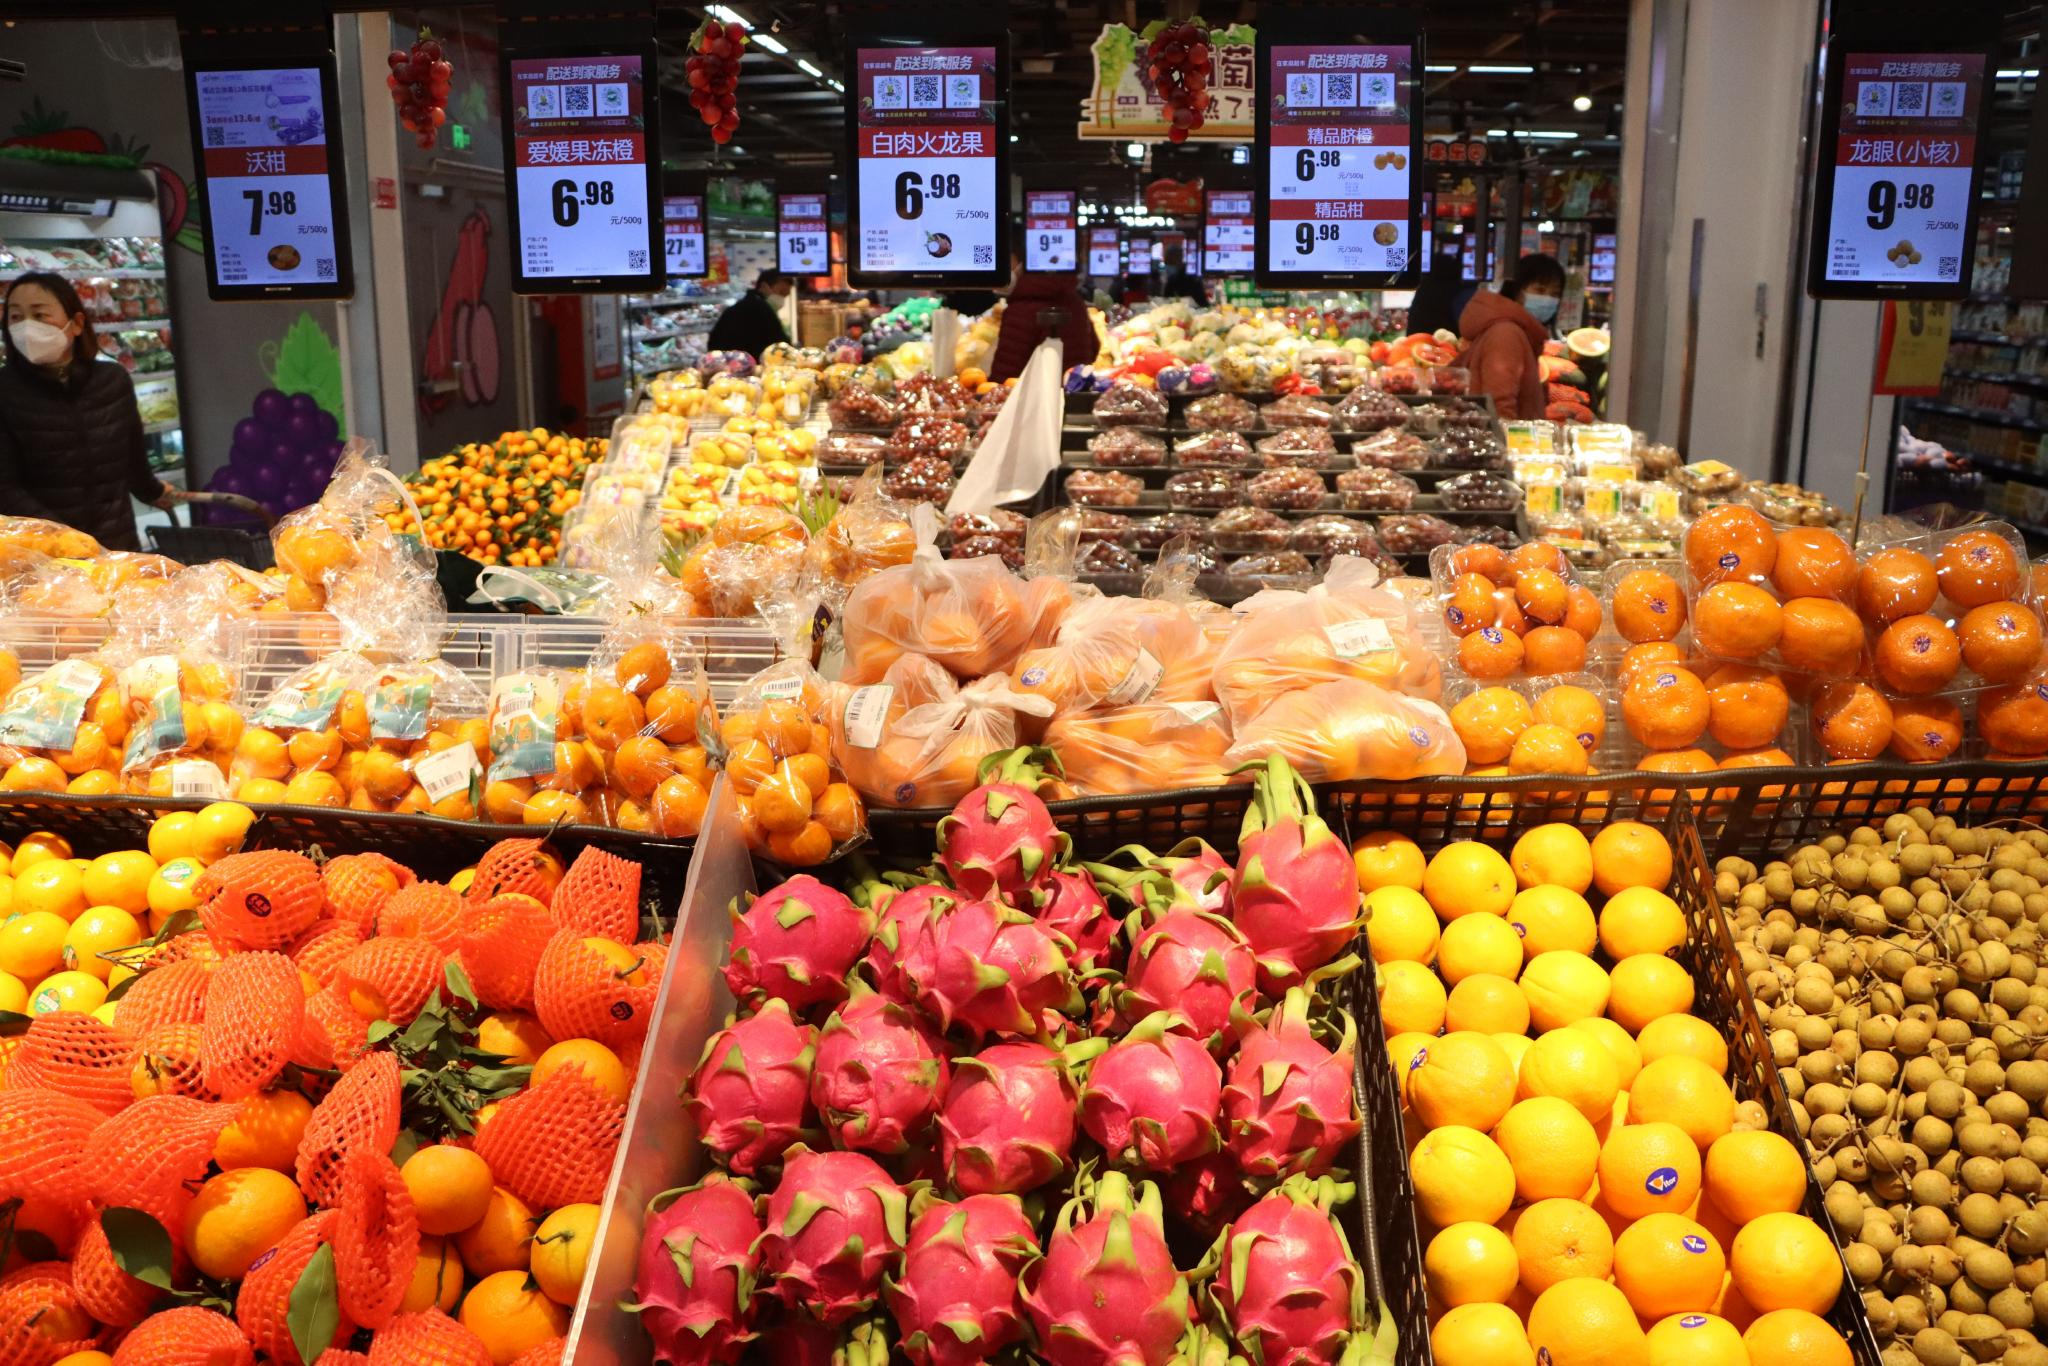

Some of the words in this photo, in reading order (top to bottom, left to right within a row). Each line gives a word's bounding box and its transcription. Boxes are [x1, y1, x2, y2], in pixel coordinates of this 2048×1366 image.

[893, 55, 973, 71] 配送到家服务
[1307, 53, 1389, 69] 配送到家服务
[1880, 61, 1963, 77] 配送到家服务
[546, 64, 621, 81] 配送到家服务
[872, 131, 984, 155] 白肉火龙果
[1307, 127, 1373, 145] 精品脐橙
[527, 138, 635, 164] 爱媛果冻橙
[1848, 139, 1961, 165] 龙眼(小核)
[245, 150, 286, 174] 沃柑
[1295, 148, 1341, 182] 6.98
[1337, 171, 1364, 180] 元/500g
[551, 178, 615, 228] 6.98
[894, 170, 961, 221] 6.98
[242, 189, 297, 236] 7.98
[955, 209, 990, 221] 元/500g
[1314, 201, 1364, 219] 精品柑
[1865, 180, 1935, 232] 9.98
[297, 224, 328, 235] 元/500g
[610, 215, 642, 226] 元/500g
[1925, 220, 1960, 232] 元/500g
[666, 237, 696, 256] 27.98
[788, 236, 819, 254] 15.98
[1039, 233, 1063, 252] 9.98
[1295, 221, 1340, 256] 9.98
[1337, 245, 1363, 254] 元/500g
